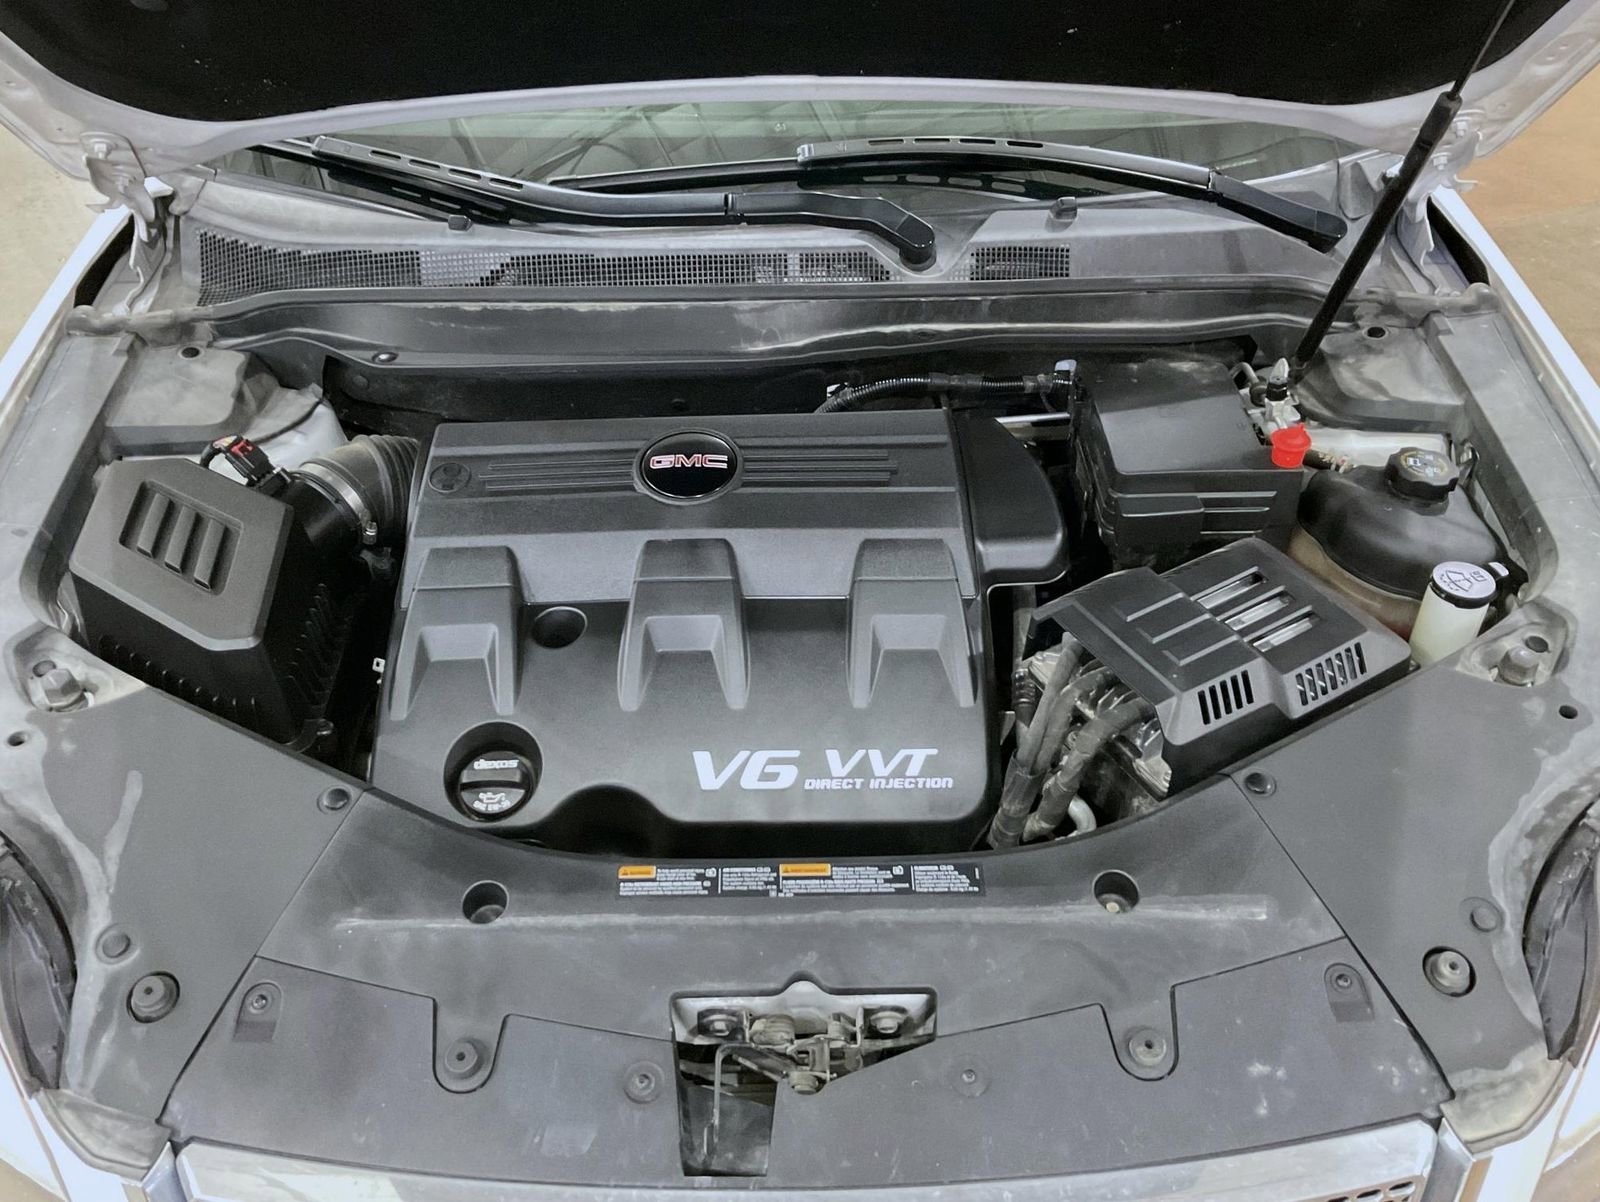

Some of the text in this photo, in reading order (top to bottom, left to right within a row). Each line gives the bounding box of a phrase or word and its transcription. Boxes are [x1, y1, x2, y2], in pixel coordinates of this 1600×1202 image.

[650, 454, 728, 469] GMC
[692, 749, 938, 790] V6 VVT
[804, 777, 953, 789] DIRECT INJECTION
